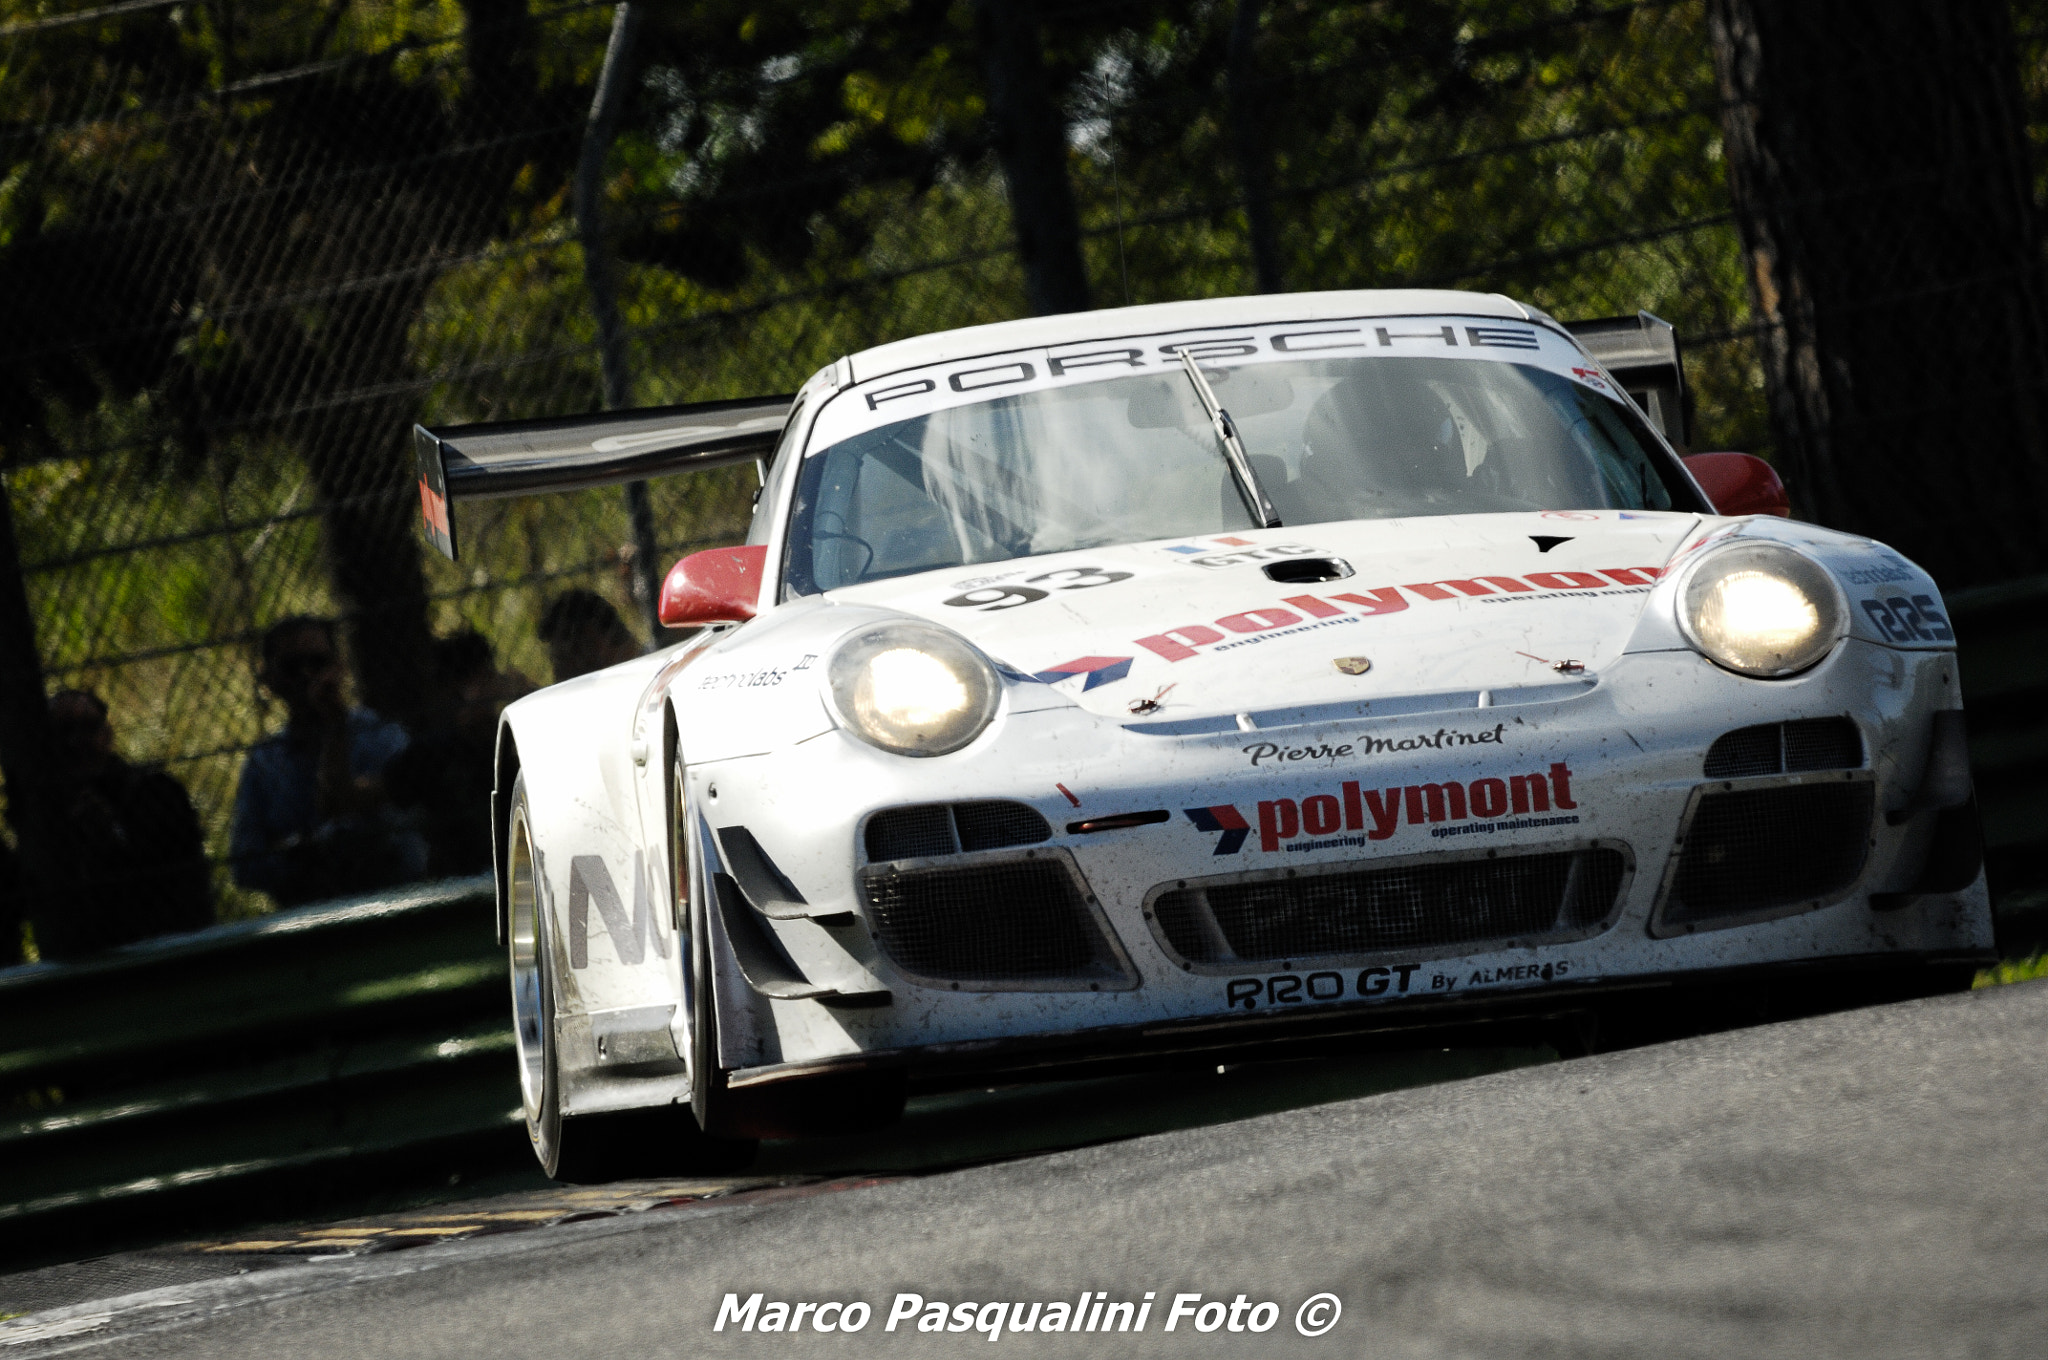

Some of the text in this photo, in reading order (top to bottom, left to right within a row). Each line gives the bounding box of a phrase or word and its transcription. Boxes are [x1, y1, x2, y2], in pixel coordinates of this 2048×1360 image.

[865, 325, 1540, 412] PORSCHE
[1190, 545, 1316, 567] GTC
[942, 567, 1135, 612] 93
[1481, 590, 1598, 605] operating
[1214, 616, 1360, 652] engineering
[1242, 723, 1508, 766] Pierre Martinet
[1257, 762, 1577, 852] polymont
[1286, 834, 1366, 853] engineering
[1431, 815, 1580, 838] operating maintenance
[1357, 964, 1421, 996] GT
[1432, 975, 1458, 991] By
